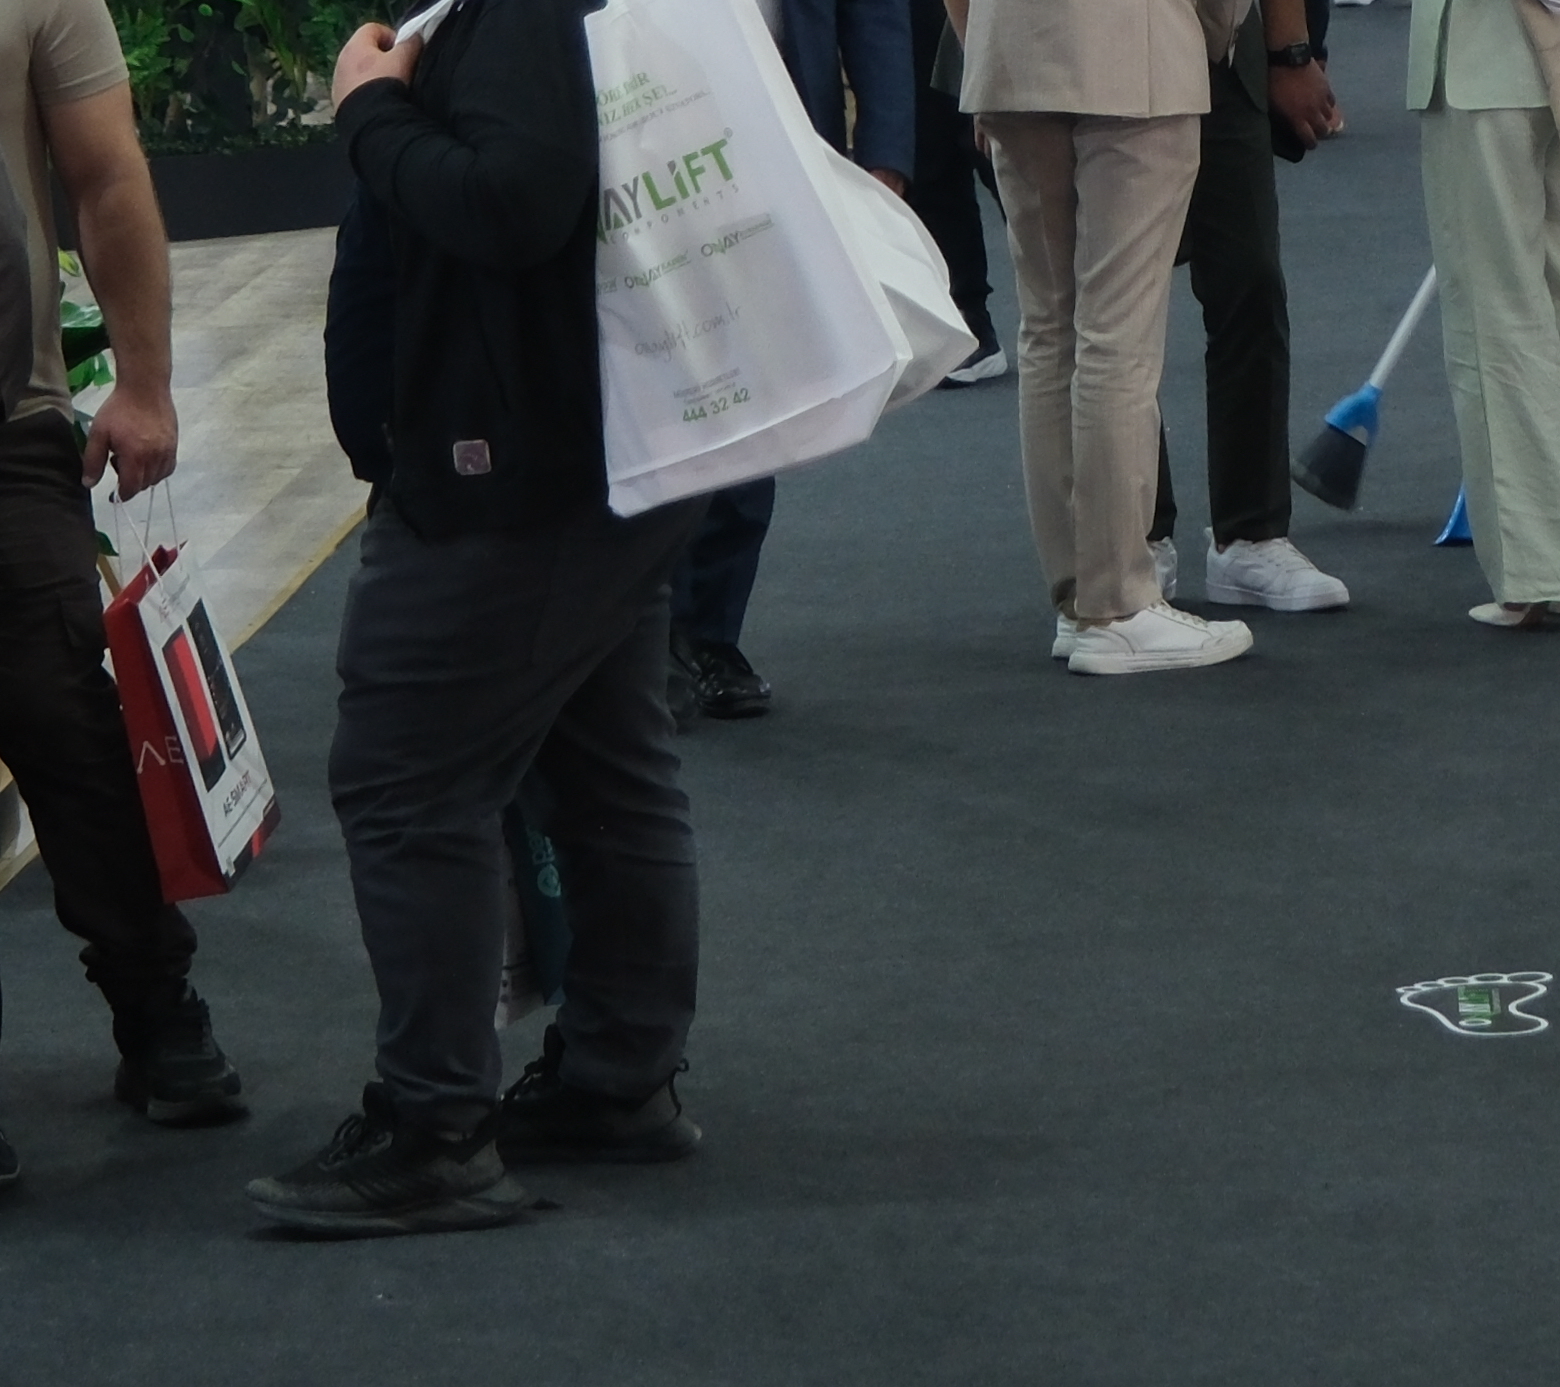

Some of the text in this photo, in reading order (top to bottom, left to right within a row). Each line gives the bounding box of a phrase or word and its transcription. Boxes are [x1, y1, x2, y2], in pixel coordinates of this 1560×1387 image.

[683, 387, 751, 423] 444 32 42
